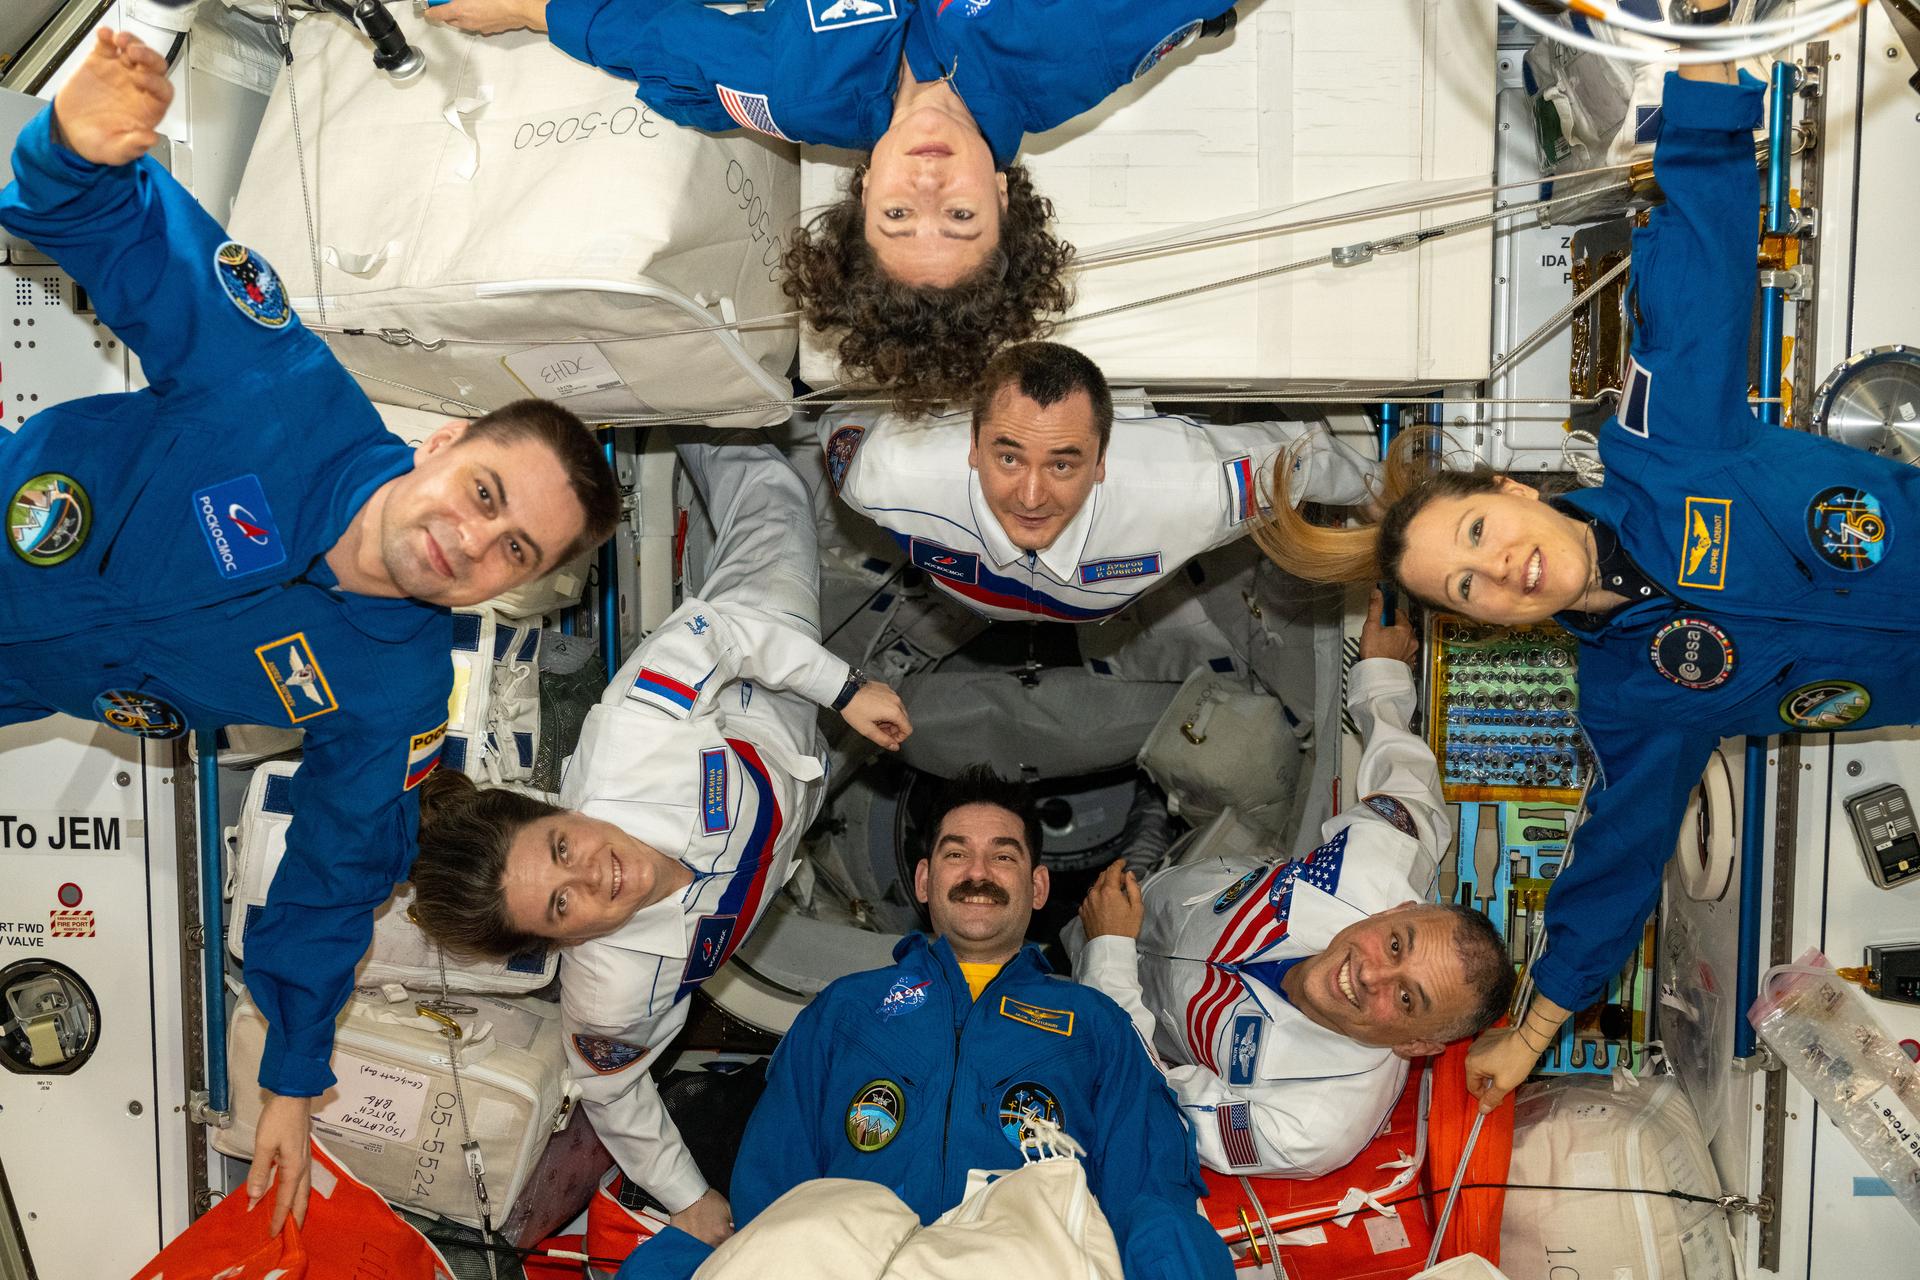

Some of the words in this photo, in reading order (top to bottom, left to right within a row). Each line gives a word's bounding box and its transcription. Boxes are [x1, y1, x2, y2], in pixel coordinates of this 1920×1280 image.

[1541, 255, 1567, 267] IDA
[198, 495, 238, 573] РОСКОСМОС
[1713, 515, 1722, 544] ADENOT
[1709, 548, 1720, 574] SOPHIE
[1684, 630, 1701, 662] esa
[0, 816, 37, 848] To
[48, 816, 121, 850] JEM
[18, 923, 44, 933] FWD
[6, 936, 44, 947] VALVE
[883, 988, 925, 1006] NASA
[362, 1093, 393, 1110] BAG
[340, 1113, 407, 1138] ISOLATION
[1882, 1107, 1911, 1142] Probe
[411, 1092, 457, 1197] 0.5-5524
